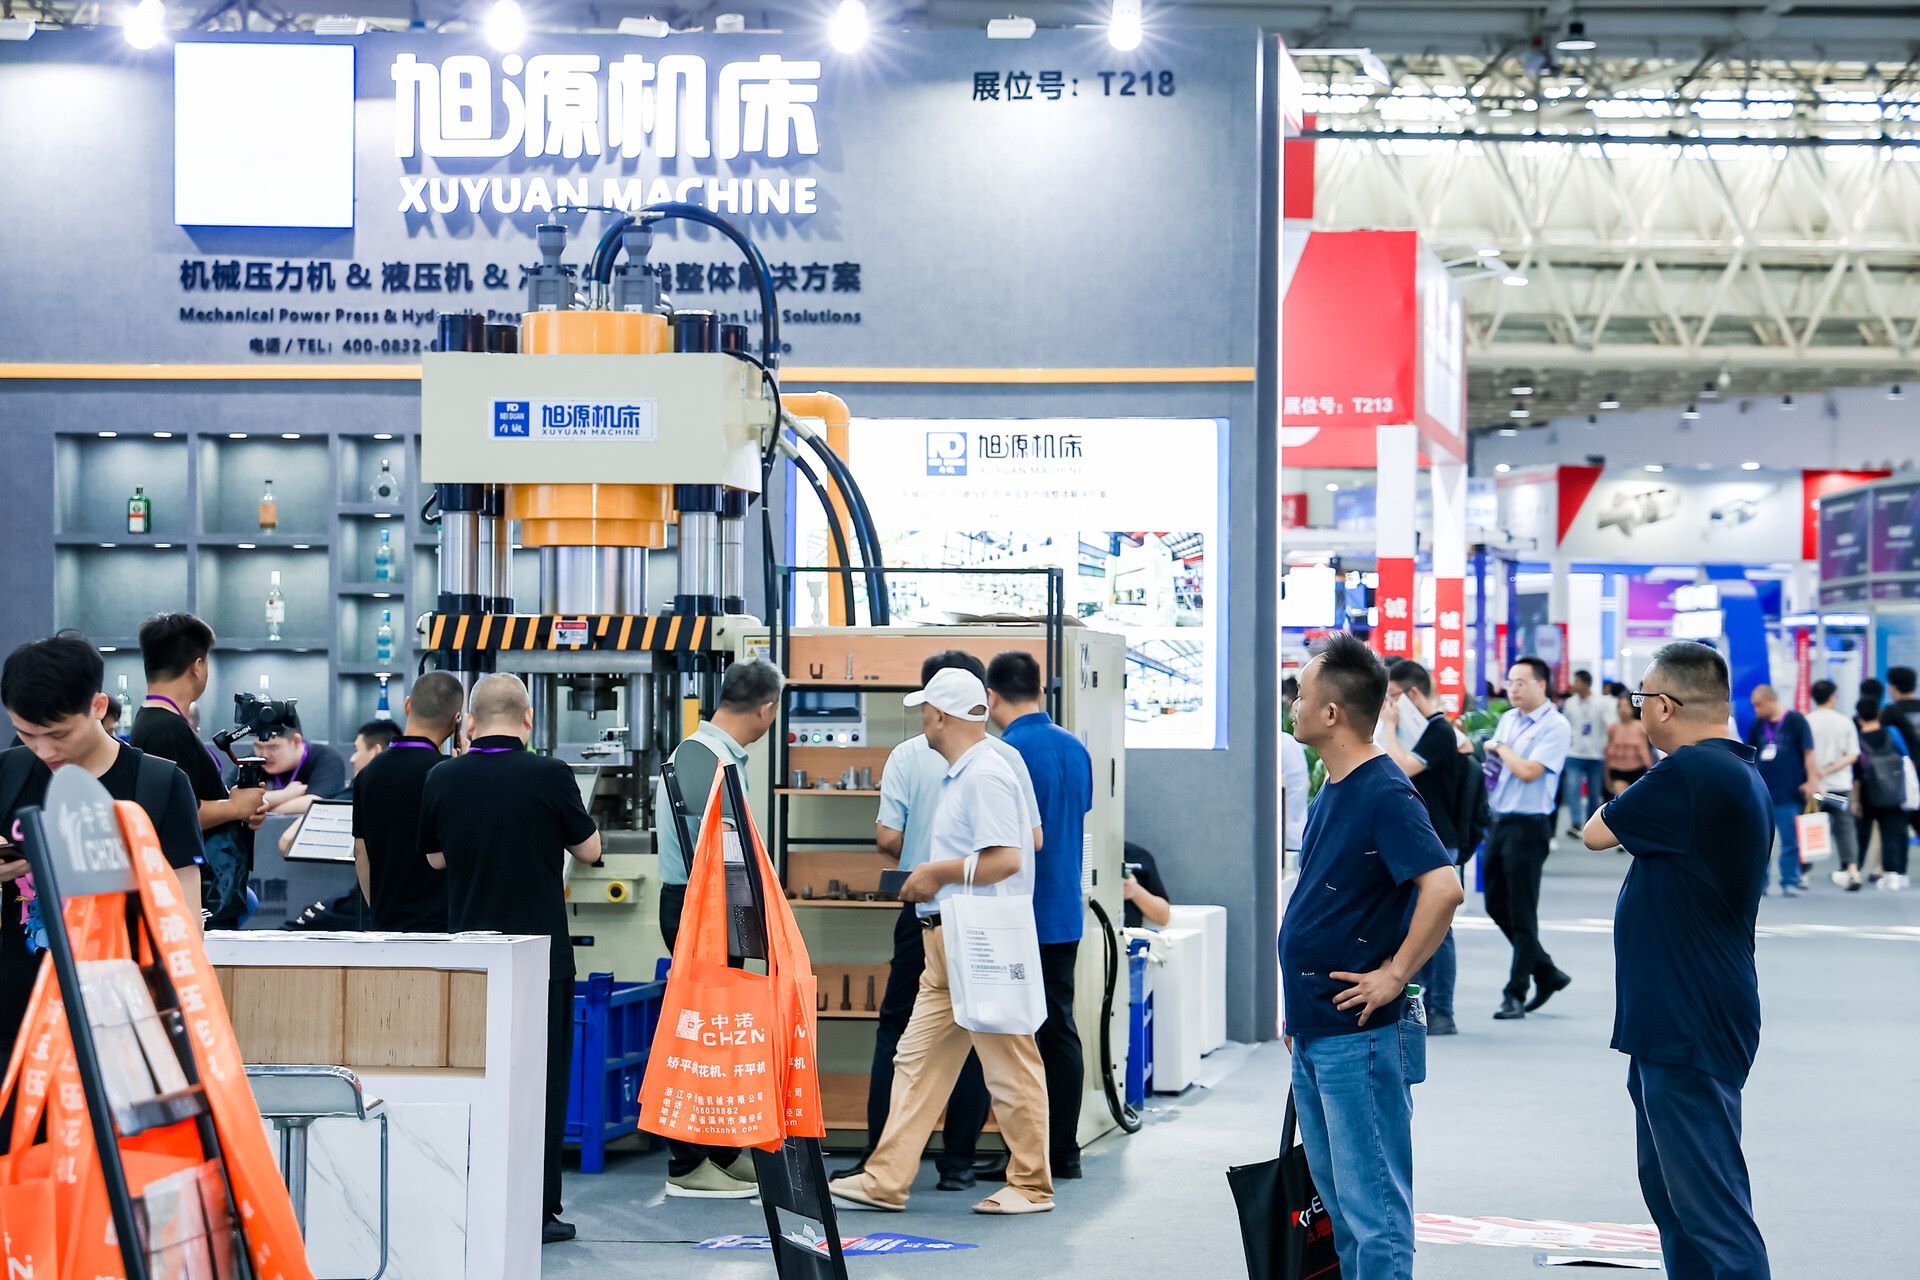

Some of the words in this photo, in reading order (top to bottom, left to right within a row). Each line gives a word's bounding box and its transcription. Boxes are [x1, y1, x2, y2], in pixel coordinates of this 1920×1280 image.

[972, 70, 1079, 101] 展位号：
[1097, 70, 1176, 97] T218
[390, 52, 822, 158] 旭源机床
[398, 178, 588, 213] XUYUAN
[603, 178, 818, 214] MACHINE
[180, 259, 336, 293] 机械压力机
[346, 263, 372, 290] &
[381, 260, 474, 293] 液压机
[482, 264, 509, 290] &
[179, 307, 274, 323] Mechanical
[278, 308, 331, 323] Power
[335, 308, 379, 323] Press
[383, 308, 398, 323] &
[783, 308, 862, 325] Solutions
[249, 338, 280, 354] 电话
[1352, 396, 1394, 414] T213
[542, 404, 641, 429] 旭源机床
[978, 433, 1083, 460] 旭源机床
[231, 725, 252, 740] RONIN
[711, 1013, 755, 1031] 中诺
[702, 1028, 766, 1047] CHZN
